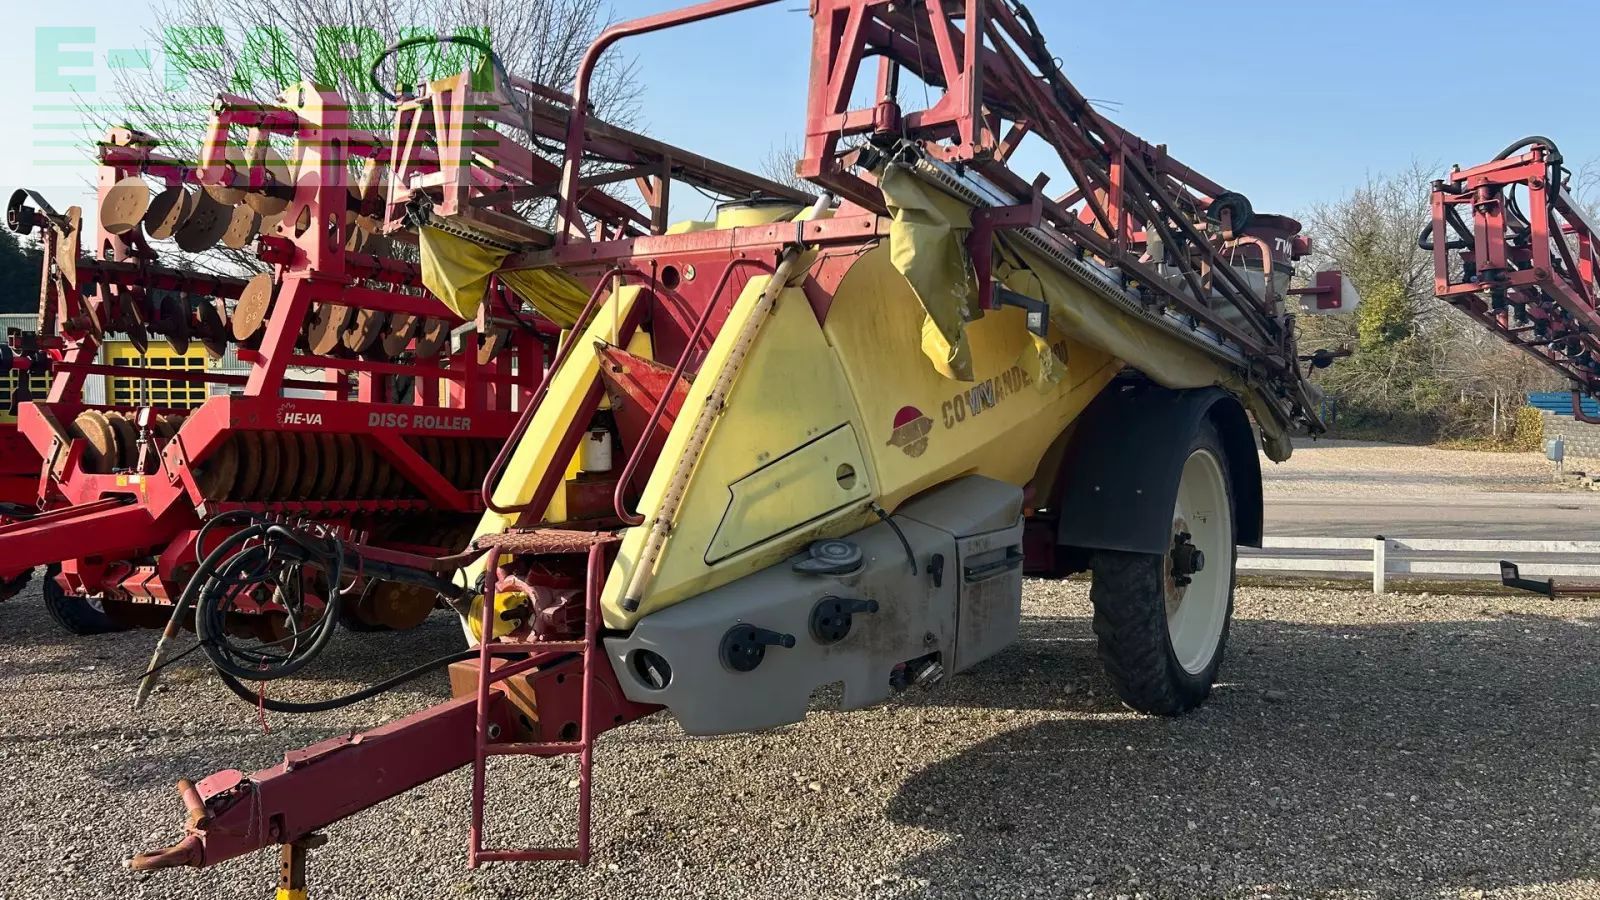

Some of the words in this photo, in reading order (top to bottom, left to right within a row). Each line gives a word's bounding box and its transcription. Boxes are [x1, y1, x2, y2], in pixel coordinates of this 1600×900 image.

[1275, 237, 1292, 256] TW
[941, 366, 1034, 429] COMMANDE
[284, 413, 322, 425] HE-VA
[368, 412, 409, 428] DISC
[412, 415, 471, 430] ROLLER
